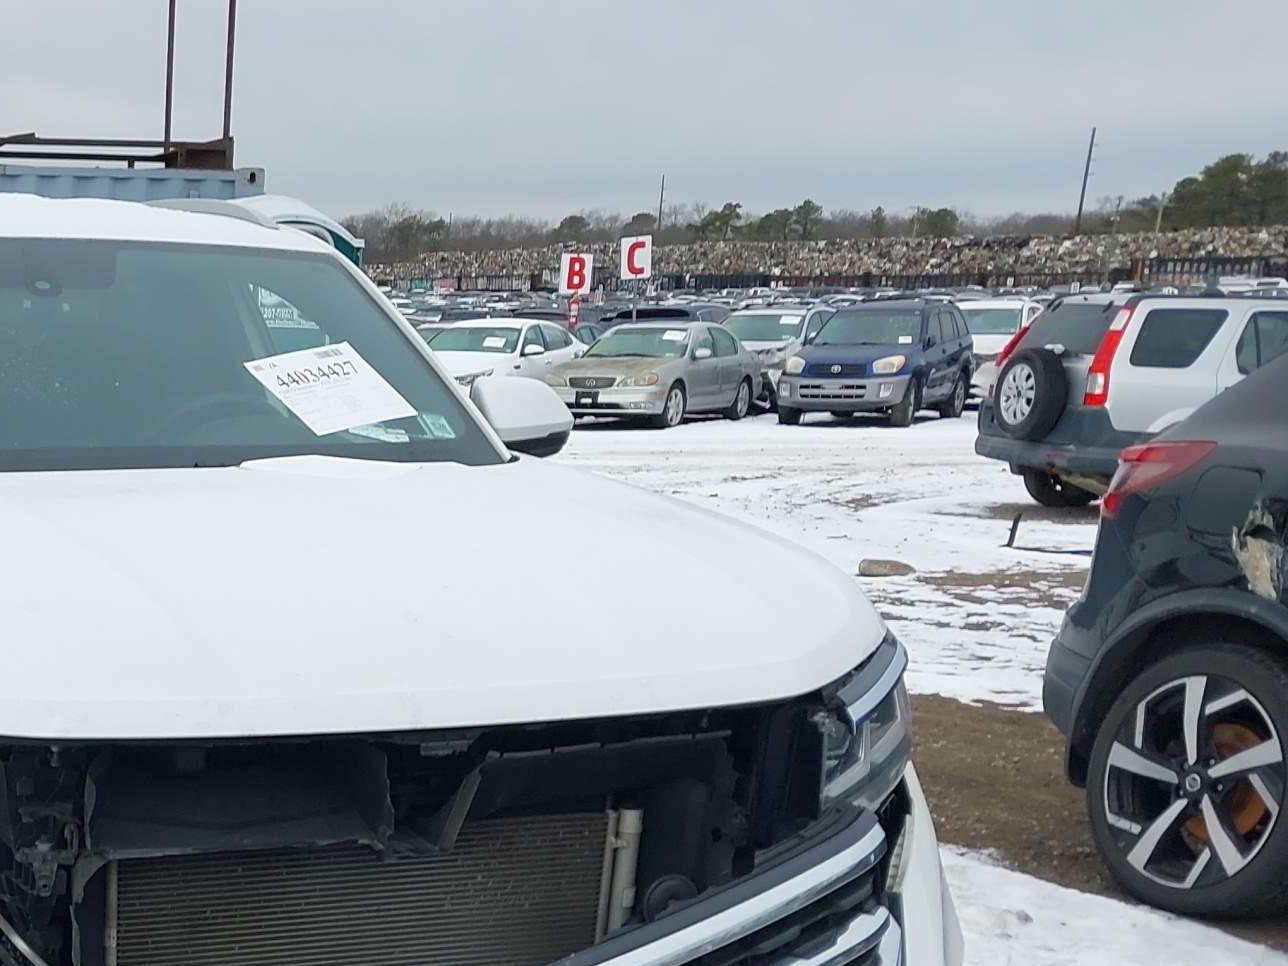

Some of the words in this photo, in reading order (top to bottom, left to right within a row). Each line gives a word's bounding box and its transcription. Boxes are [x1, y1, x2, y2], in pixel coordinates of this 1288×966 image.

[566, 256, 586, 290] B
[627, 241, 647, 275] C
[276, 360, 359, 388] 44034427
